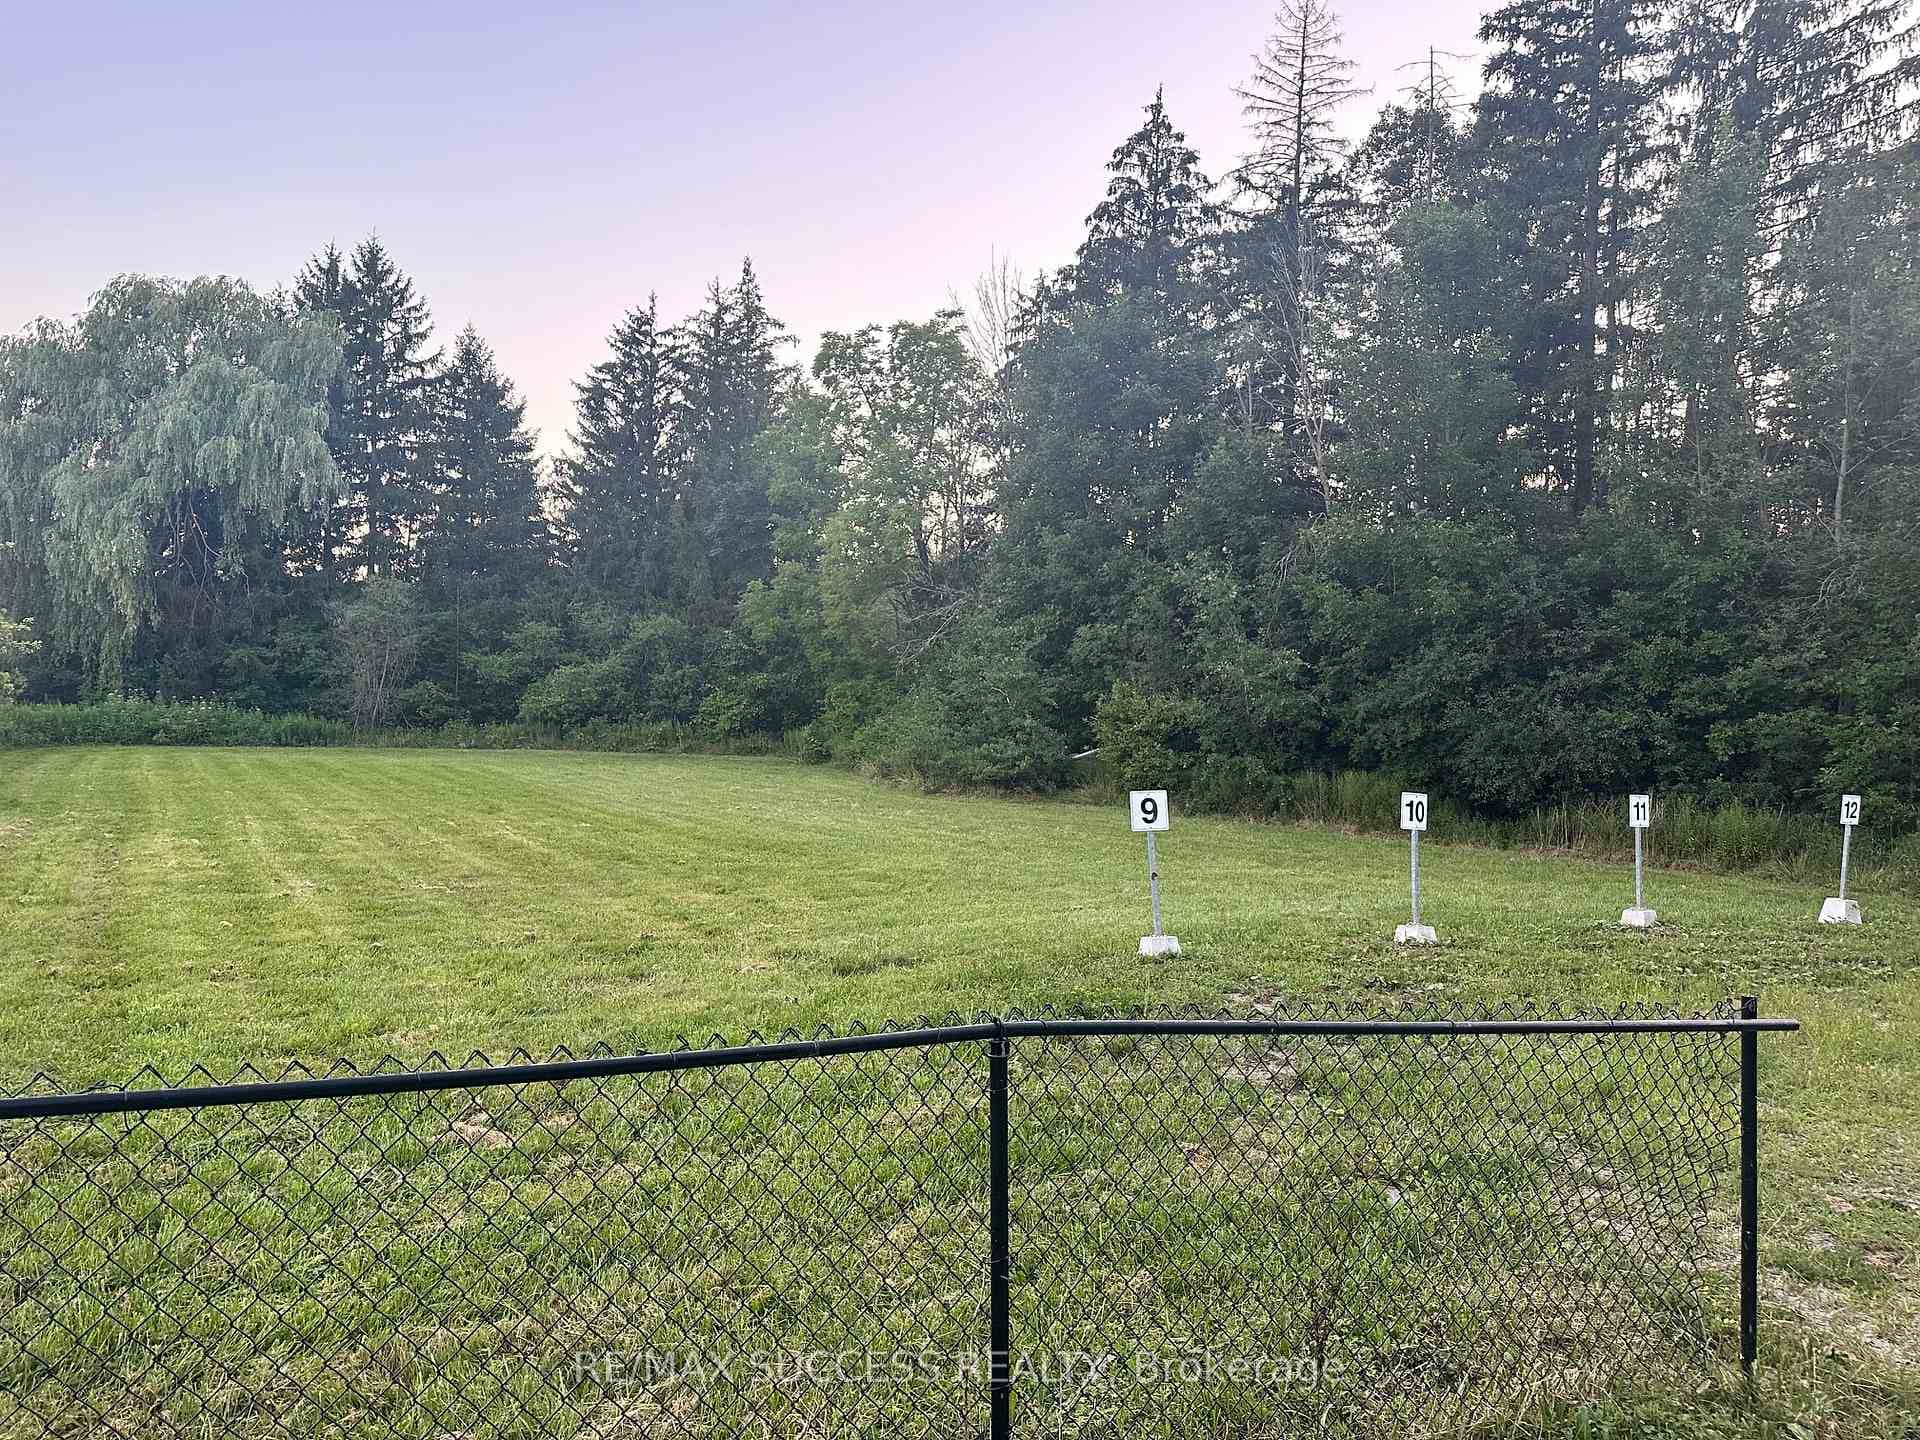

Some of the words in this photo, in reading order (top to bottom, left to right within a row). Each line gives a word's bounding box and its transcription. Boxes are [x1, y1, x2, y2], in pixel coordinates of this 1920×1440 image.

[1140, 797, 1159, 824] 9
[1405, 799, 1425, 823] 10
[1633, 802, 1646, 821] 11
[1844, 801, 1858, 819] 12
